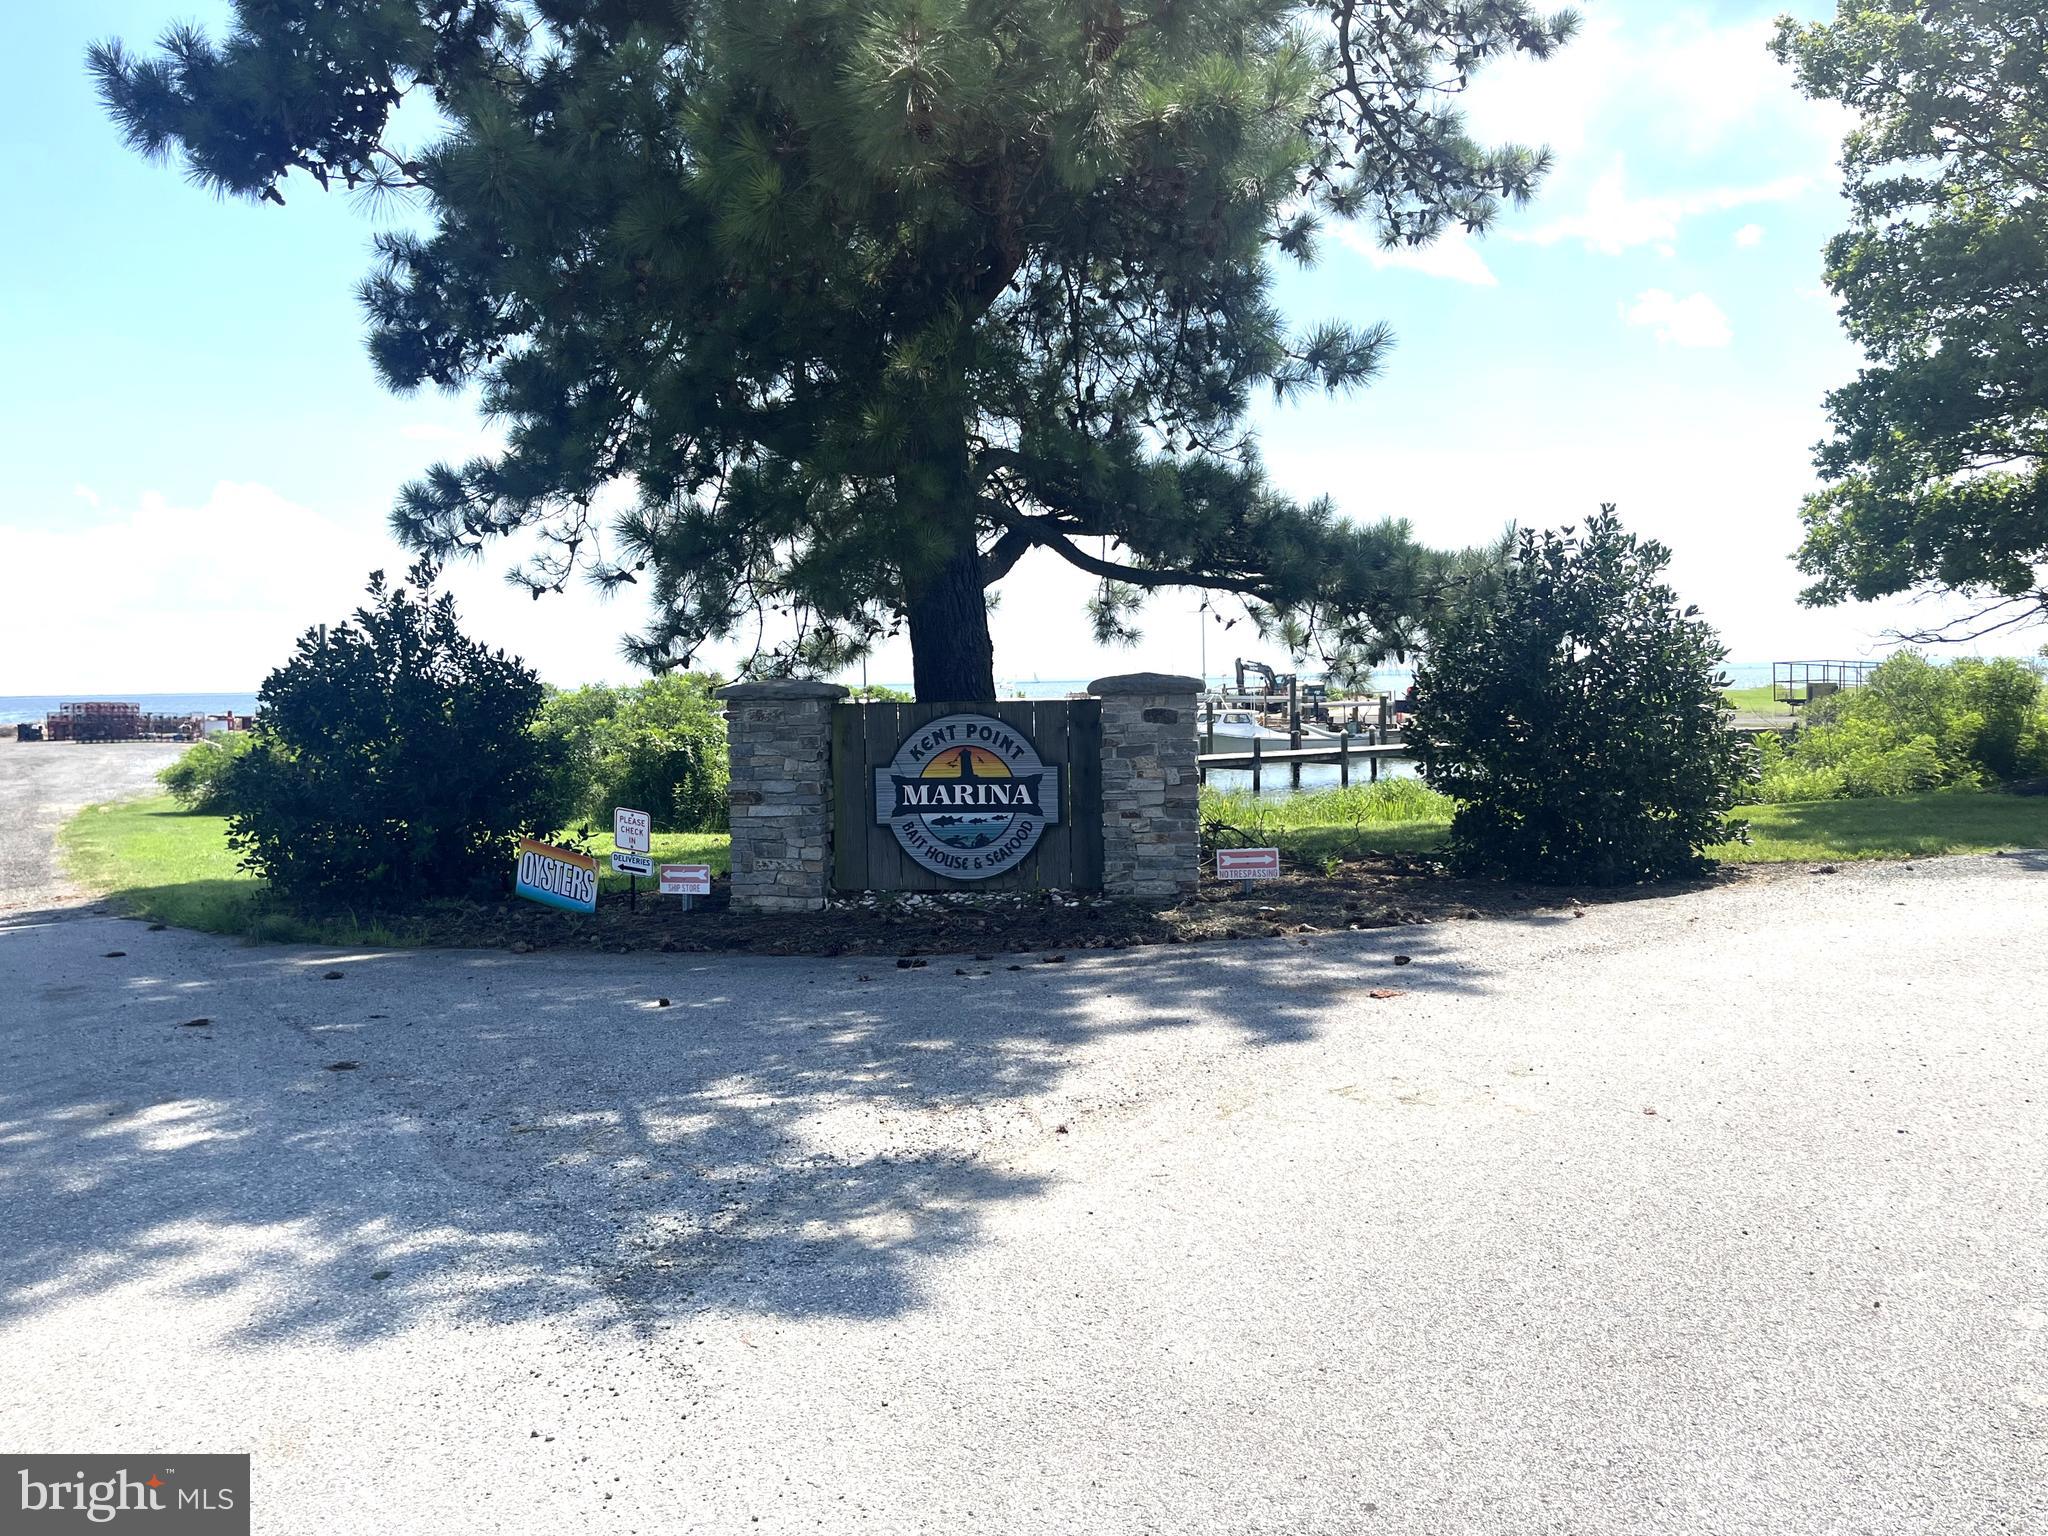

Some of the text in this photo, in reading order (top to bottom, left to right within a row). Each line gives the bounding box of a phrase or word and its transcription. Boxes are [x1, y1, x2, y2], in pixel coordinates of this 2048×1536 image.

[909, 723, 1025, 762] KENT POINT
[902, 784, 1034, 805] MARINA
[619, 815, 646, 827] PLEASE
[620, 825, 644, 837] CHECK
[628, 836, 636, 845] IN
[902, 820, 1034, 870] BAIT HOUSE & SEAFOOD
[613, 854, 651, 867] DELIVERIES
[521, 850, 595, 903] OYSTERS
[1219, 869, 1278, 878] NO TRESPASSING
[668, 884, 701, 892] SHIP STORE
